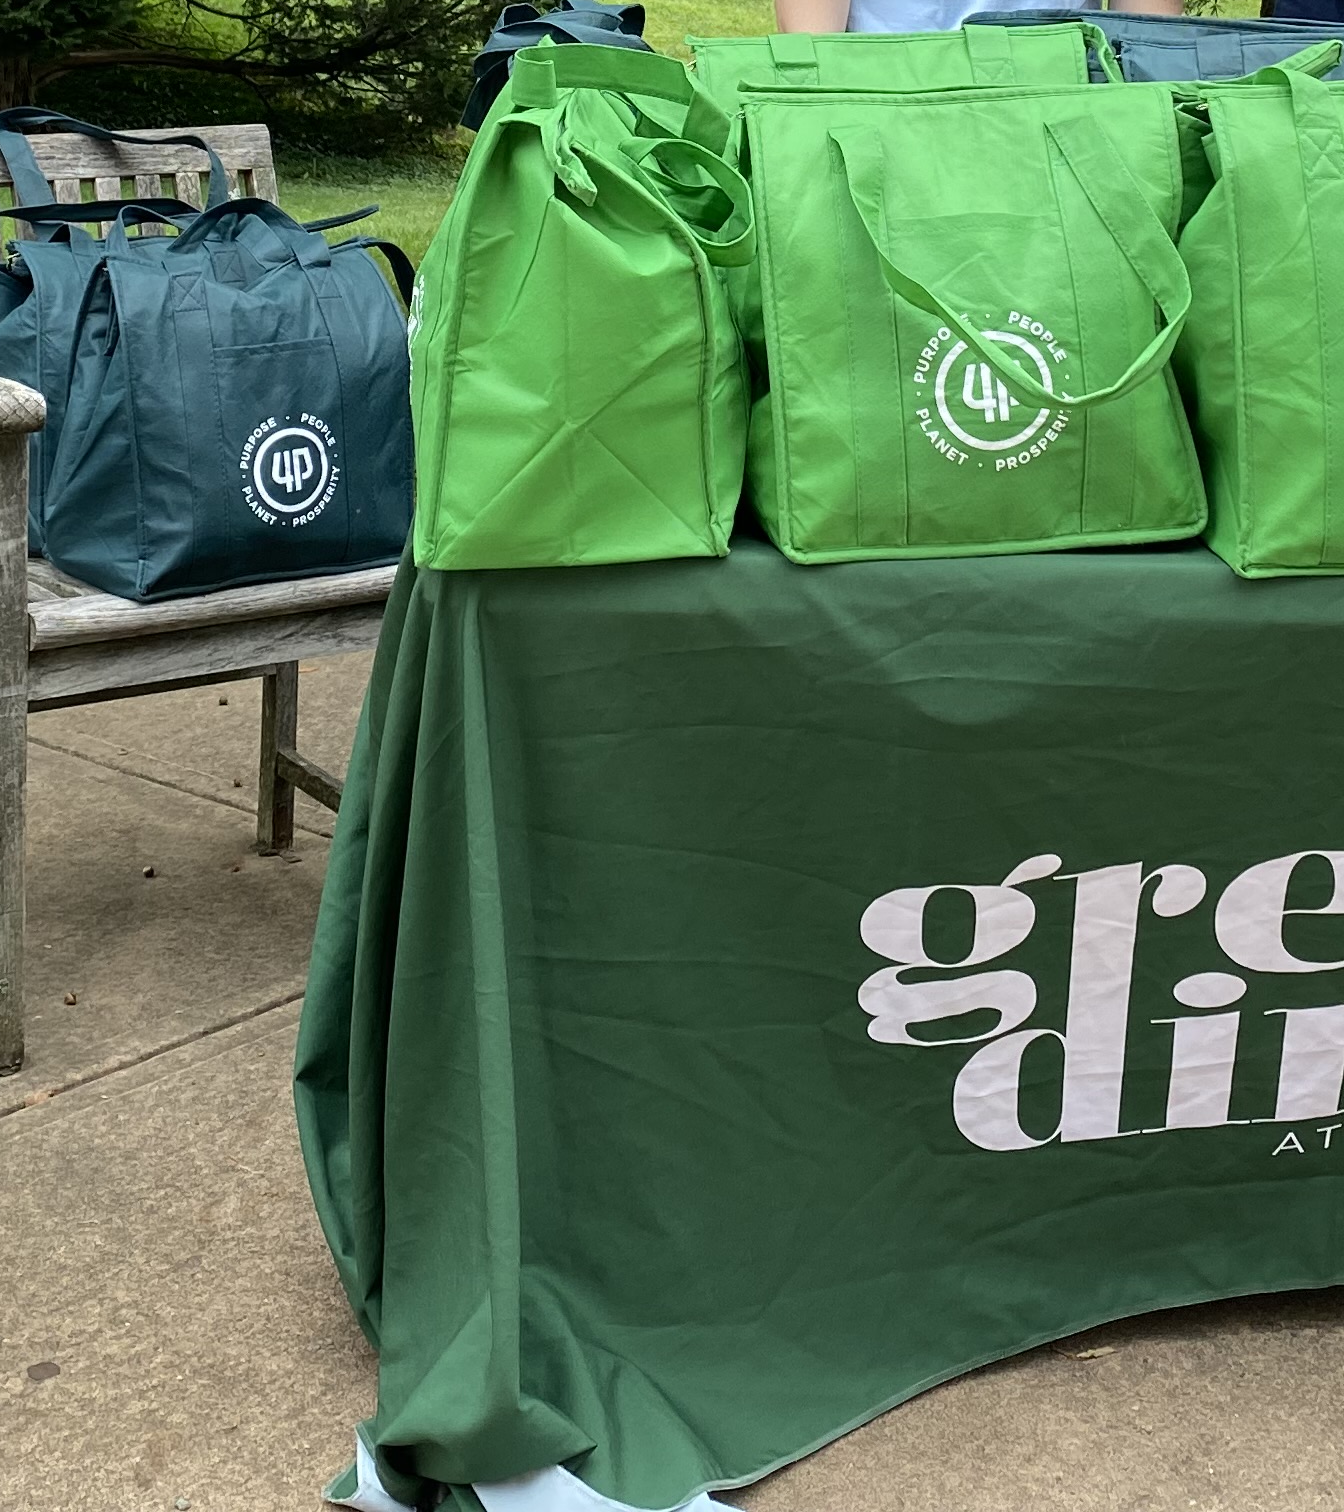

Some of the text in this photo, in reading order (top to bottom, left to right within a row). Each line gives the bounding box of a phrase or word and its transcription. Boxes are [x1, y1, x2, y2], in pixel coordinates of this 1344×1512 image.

[1008, 311, 1067, 363] PEOPLE
[240, 413, 336, 469] PURPOSE PEOPLE
[916, 392, 1074, 472] PLANET PROSPERIY
[242, 466, 340, 527] PLANET PROSPERITY
[272, 447, 313, 493] 4P
[1272, 1123, 1343, 1156] AT
